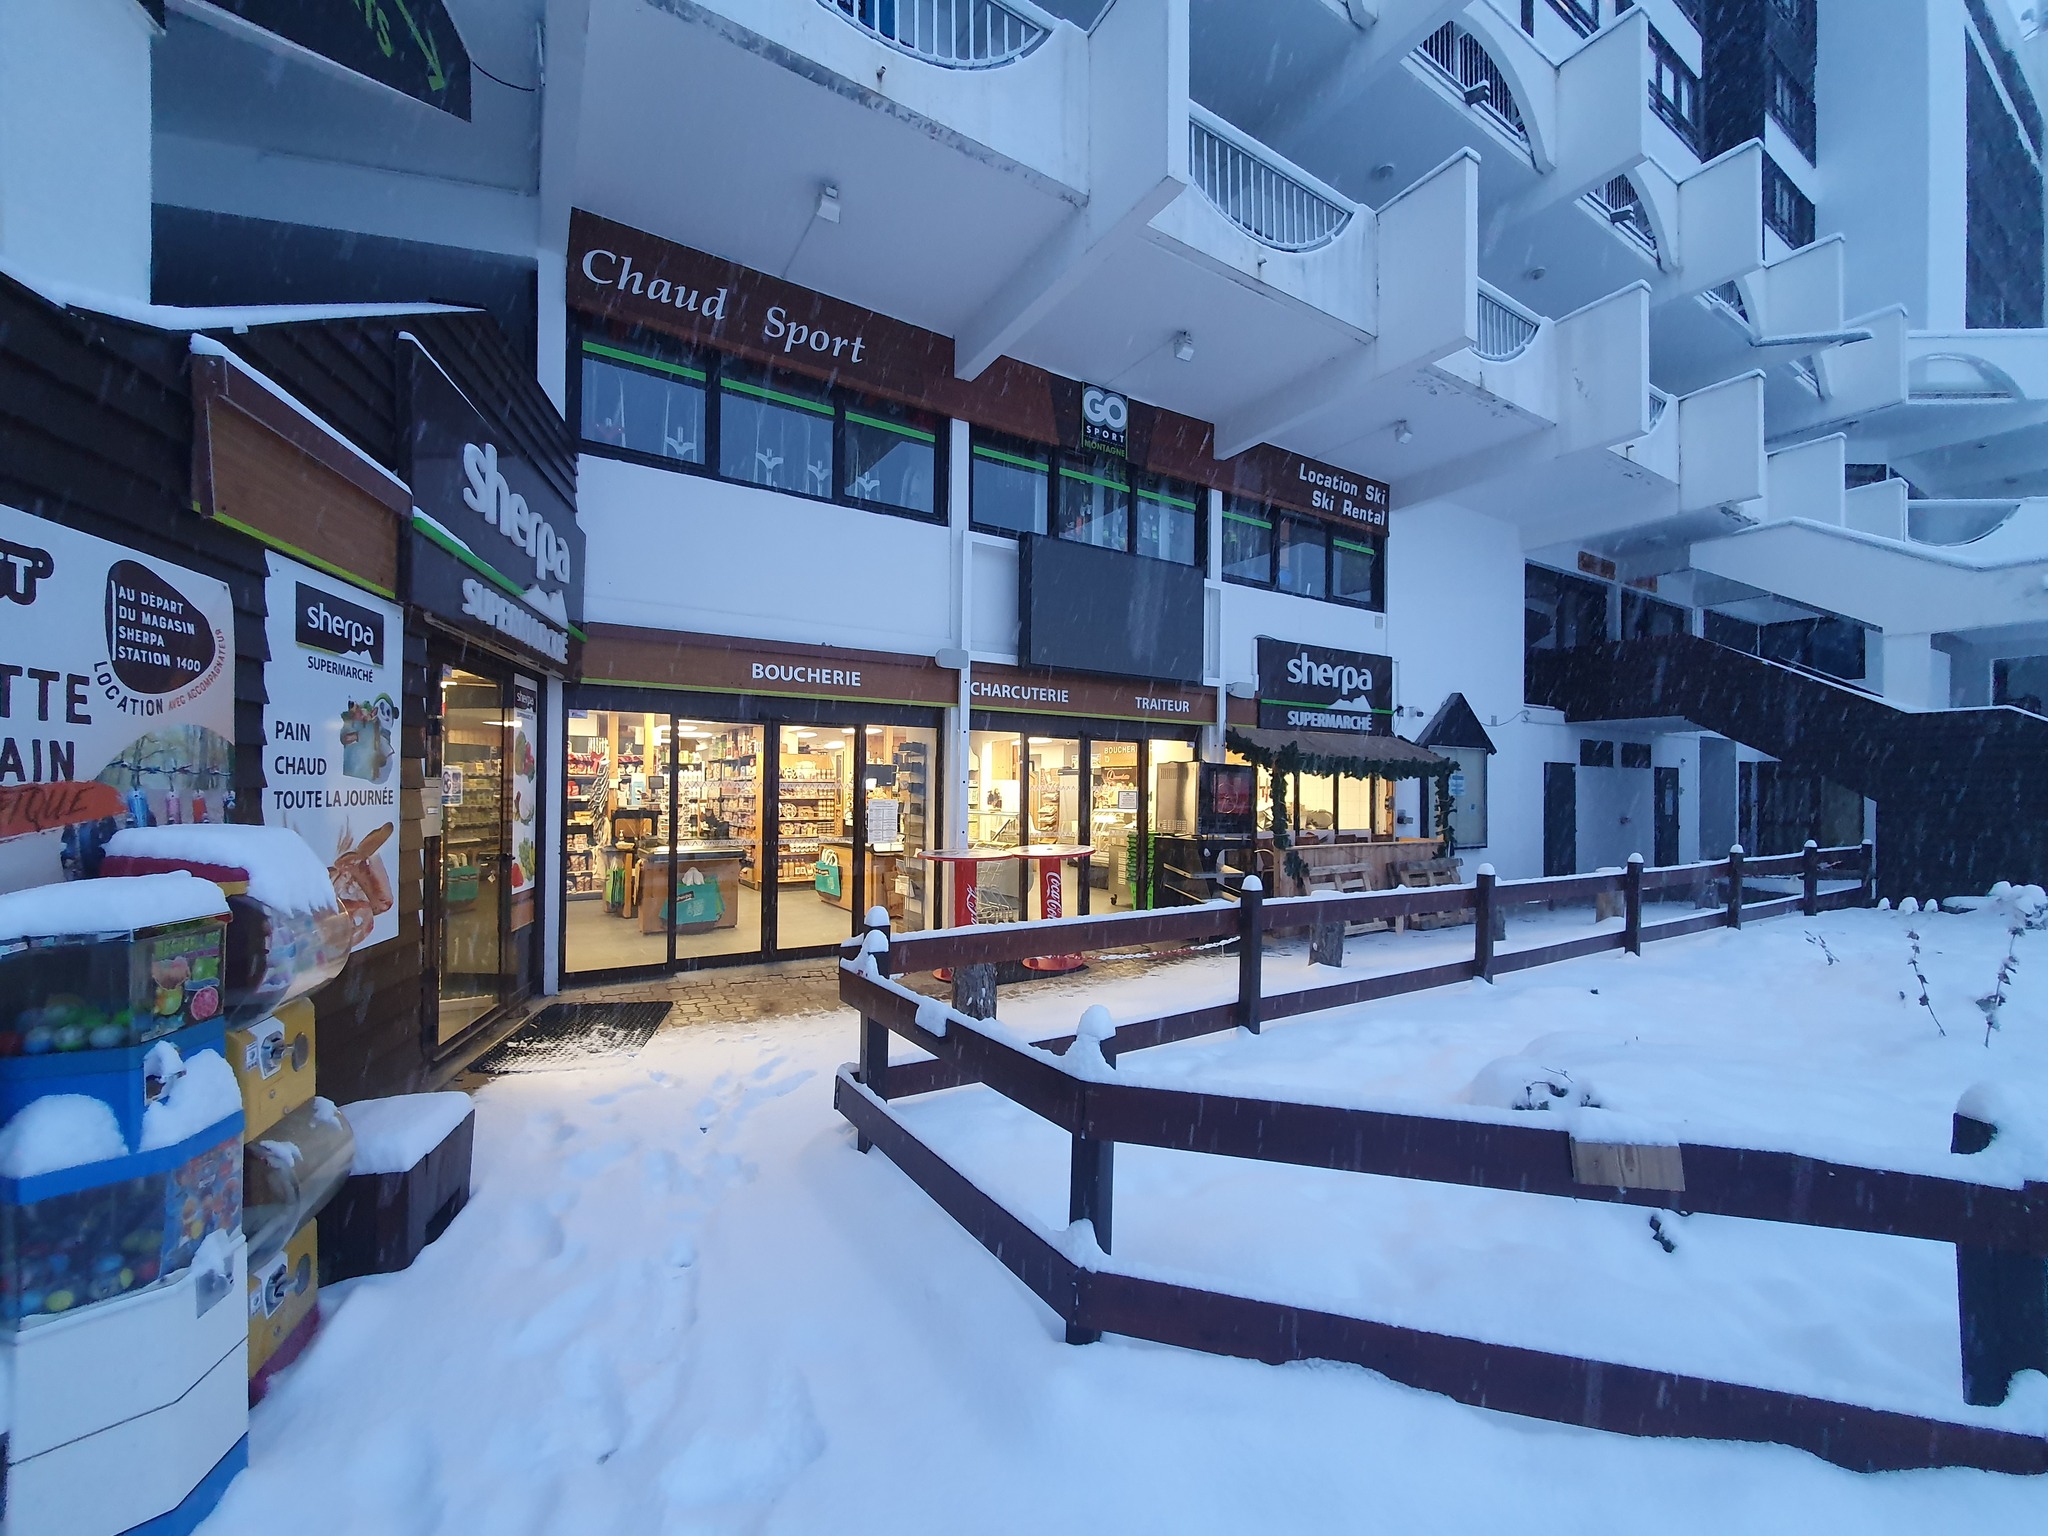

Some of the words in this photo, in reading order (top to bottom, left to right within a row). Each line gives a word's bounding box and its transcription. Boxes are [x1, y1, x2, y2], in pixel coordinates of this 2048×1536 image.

[582, 249, 728, 321] Chaud
[764, 306, 866, 363] Sport
[1083, 390, 1127, 428] GO
[1086, 425, 1124, 443] SPORT
[1084, 439, 1125, 457] MONTAGNE
[1299, 463, 1358, 496] Location
[1365, 484, 1386, 505] Ski
[463, 442, 570, 584] sherpa
[1312, 490, 1335, 511] Ski
[1342, 499, 1385, 526] Rental
[118, 585, 136, 602] AU
[141, 591, 184, 615] DÉPART
[119, 605, 136, 621] DU
[141, 611, 196, 636] MAGASIN
[306, 602, 374, 647] sherpa
[118, 626, 165, 648] SHERPA
[93, 660, 164, 716] LOCATION
[168, 695, 186, 711] AVEC
[187, 628, 226, 701] ACCOMPAGNATEUR
[118, 645, 171, 667] STATION
[176, 656, 201, 672] 1400
[307, 656, 374, 683] SUPERMARCHÉ
[752, 662, 861, 687] BOUCHERIE
[1287, 652, 1372, 695] sherpa
[970, 681, 1069, 703] CHARCUTERIE
[1134, 696, 1190, 713] TRAITEUR
[275, 720, 310, 743] PAIN
[1287, 710, 1372, 731] SUPERMARCHÉ
[274, 755, 327, 775] CHAUD
[274, 790, 322, 809] TOUTE
[325, 790, 342, 808] LA
[344, 786, 394, 807] JOURNÉE
